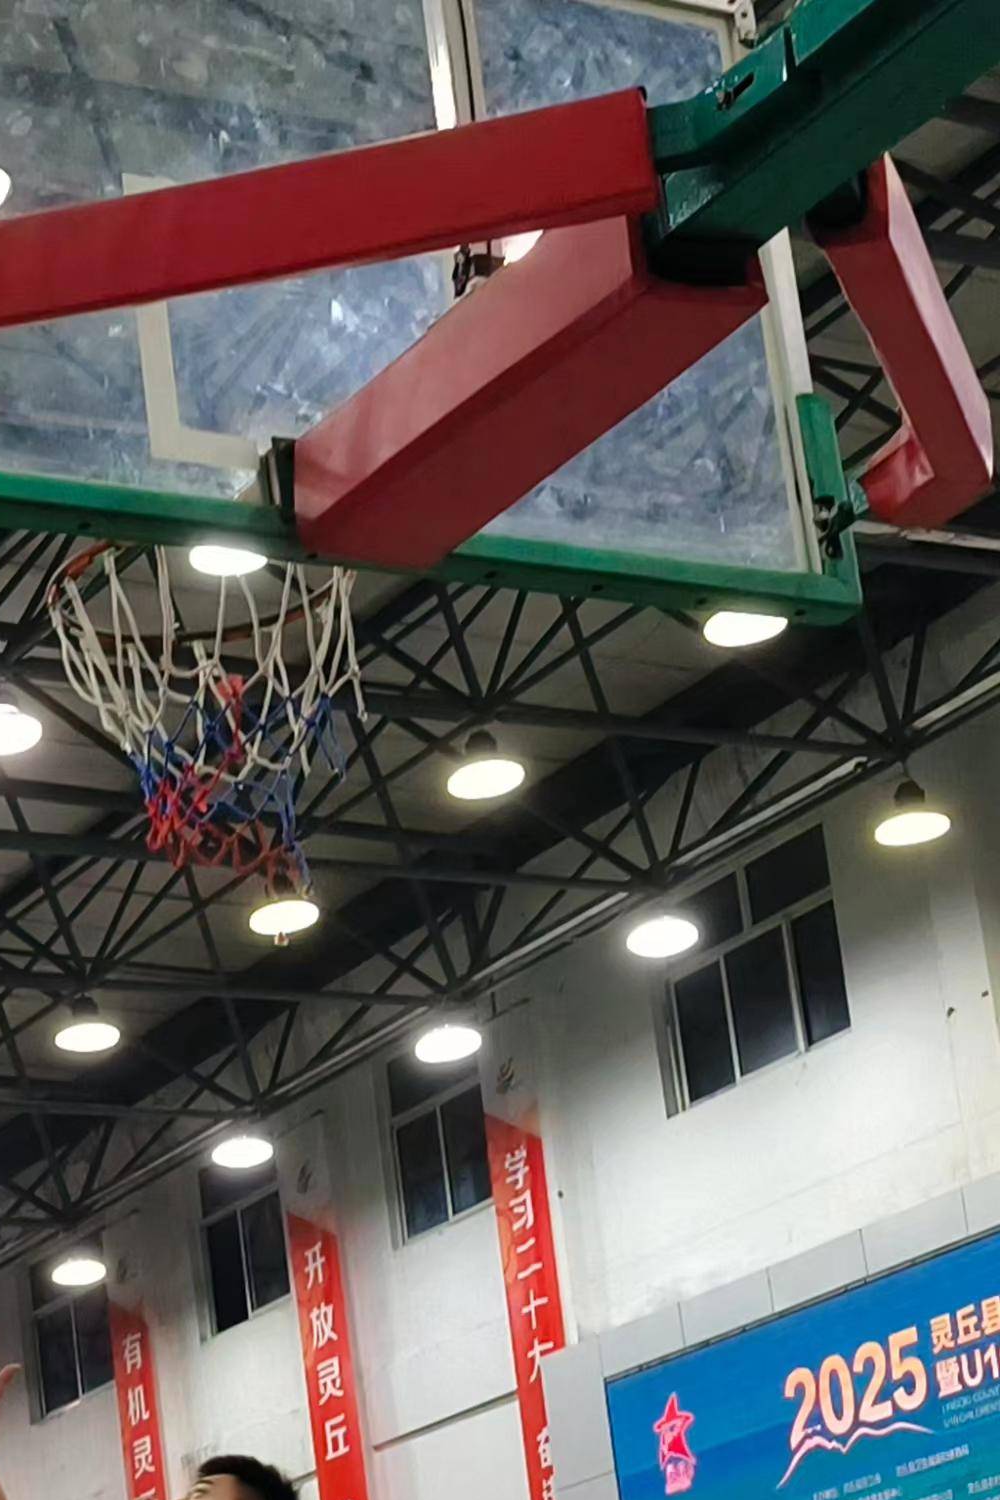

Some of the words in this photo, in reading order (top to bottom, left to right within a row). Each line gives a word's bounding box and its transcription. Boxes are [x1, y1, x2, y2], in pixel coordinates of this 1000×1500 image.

[303, 1241, 351, 1461] 开放灵丘
[503, 1146, 555, 1384] 学习二十大
[784, 1326, 928, 1451] 2025
